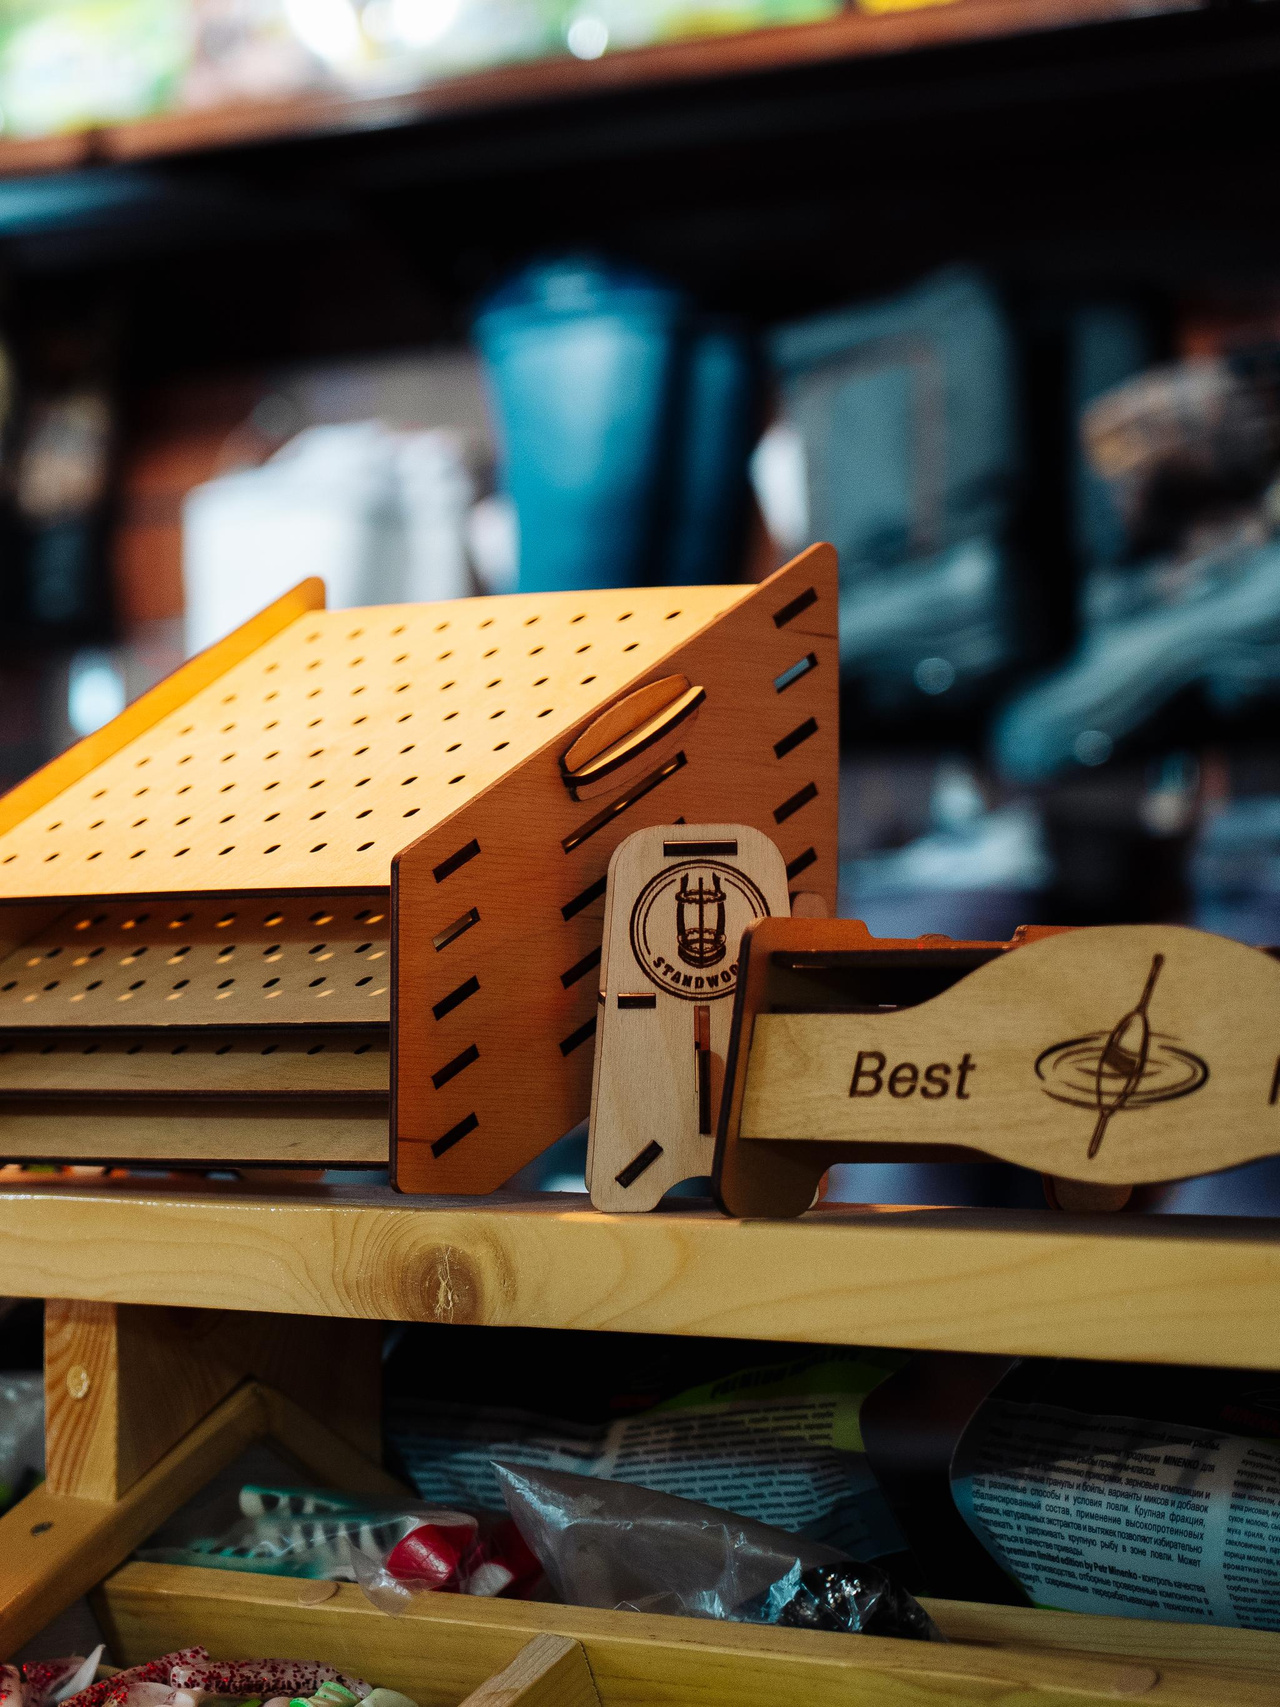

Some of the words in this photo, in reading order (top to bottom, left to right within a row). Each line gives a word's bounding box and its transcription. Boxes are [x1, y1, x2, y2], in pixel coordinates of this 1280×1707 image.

[652, 955, 738, 989] STANDWOO
[848, 1050, 977, 1100] Best
[1124, 1450, 1161, 1463] продукции
[1163, 1455, 1199, 1470] MINENKO
[1200, 1463, 1215, 1473] для
[1040, 1463, 1084, 1476] применению
[1084, 1470, 1123, 1485] прикормки,
[1125, 1477, 1160, 1490] зерновые
[1160, 1483, 1204, 1499] композиции
[1046, 1477, 1074, 1489] гранулы
[1082, 1481, 1106, 1496] бойлы,
[1108, 1488, 1142, 1501] варианты
[1144, 1494, 1169, 1506] миксов
[1176, 1500, 1209, 1513] добавок
[971, 1489, 1041, 1511] сбалансированный
[1045, 1504, 1073, 1517] состав,
[1076, 1509, 1122, 1525] применение
[1125, 1518, 1204, 1541] высокопротеиновых
[972, 1477, 986, 1488] под
[988, 1480, 1027, 1494] различные
[1030, 1487, 1061, 1501] способы
[1073, 1495, 1102, 1508] условия
[1106, 1501, 1130, 1513] ловли.
[1134, 1504, 1166, 1519] Крупная
[1169, 1511, 1205, 1528] фракция,
[1244, 1506, 1270, 1517] рисовая,
[1002, 1509, 1045, 1524] натуральных
[1046, 1517, 1081, 1531] экстрактов
[1088, 1525, 1116, 1538] вытяжек
[1117, 1530, 1153, 1545] позволяют
[1153, 1537, 1203, 1555] избирательно
[1226, 1527, 1242, 1535] мука
[1228, 1515, 1244, 1524] сухое
[1245, 1518, 1270, 1529] молоко,
[1025, 1538, 1053, 1550] качестве
[1025, 1526, 1065, 1540] удерживать
[1068, 1534, 1097, 1548] крупную
[1100, 1540, 1119, 1553] рыбу
[1130, 1546, 1147, 1557] зоне
[1150, 1550, 1174, 1562] ловли.
[1177, 1553, 1201, 1568] Может
[1006, 1546, 1037, 1558] premium
[1037, 1550, 1059, 1563] limited
[1060, 1556, 1084, 1568] edition
[1084, 1559, 1093, 1572] by
[1093, 1561, 1108, 1573] Petr
[1108, 1564, 1138, 1580] Minenko
[1141, 1574, 1174, 1588] контроль
[1173, 1581, 1206, 1593] качества
[1045, 1577, 1089, 1594] современные
[1078, 1572, 1112, 1587] отборные
[1112, 1580, 1158, 1596] проверенные
